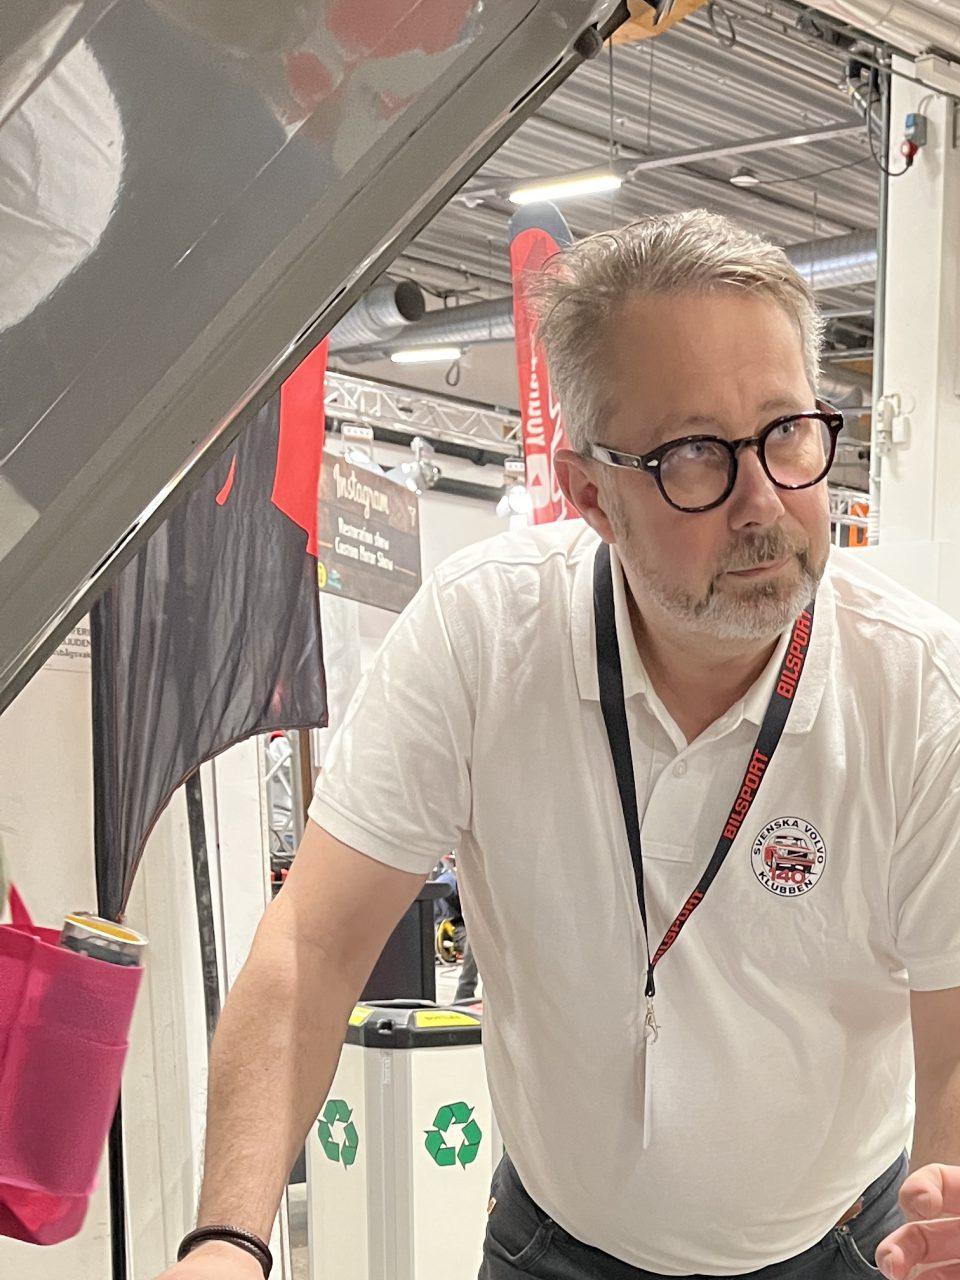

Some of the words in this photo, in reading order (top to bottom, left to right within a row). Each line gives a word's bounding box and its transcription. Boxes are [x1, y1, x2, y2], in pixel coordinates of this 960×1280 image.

[723, 748, 769, 840] BILSPORT
[753, 819, 799, 855] SVENSKA
[804, 825, 824, 864] VOLVO
[758, 871, 813, 894] KLUBBEN
[769, 868, 806, 885] 140
